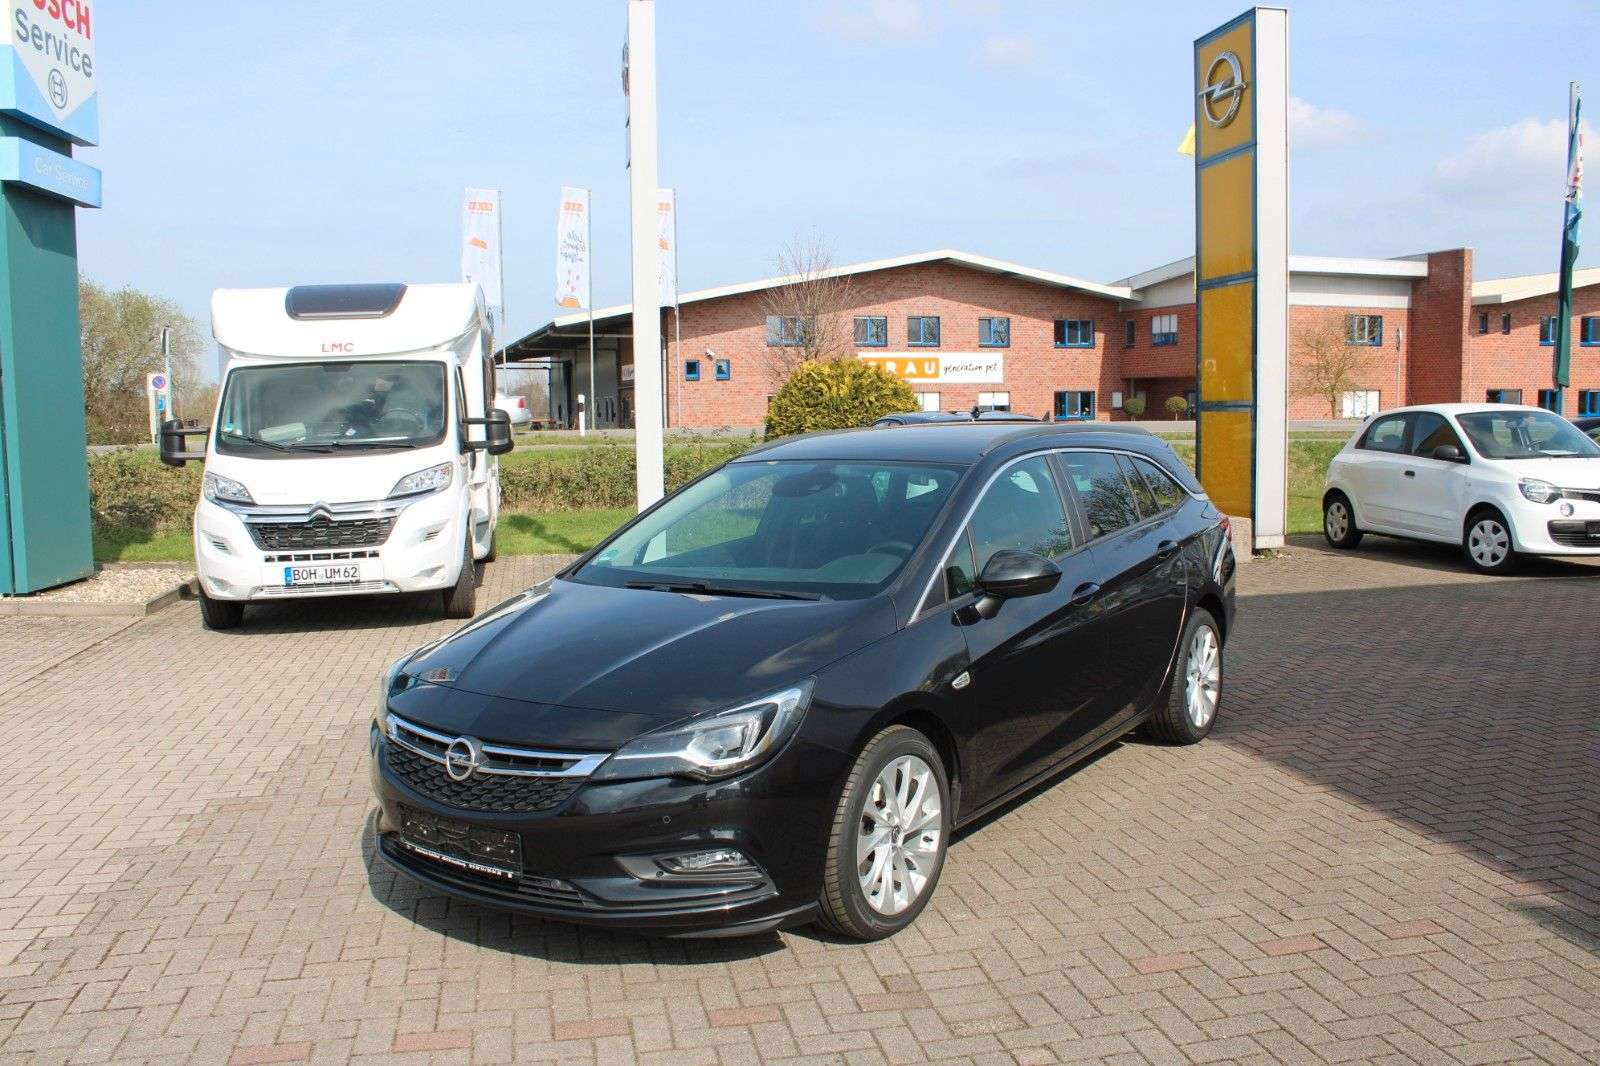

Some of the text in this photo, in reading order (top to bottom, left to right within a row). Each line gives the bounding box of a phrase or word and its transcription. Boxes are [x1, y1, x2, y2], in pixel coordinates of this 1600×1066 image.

[15, 8, 93, 78] Service
[321, 342, 355, 353] LMC
[866, 361, 936, 375] RAU
[943, 363, 983, 375] generation
[293, 566, 358, 581] BOH UM 62
